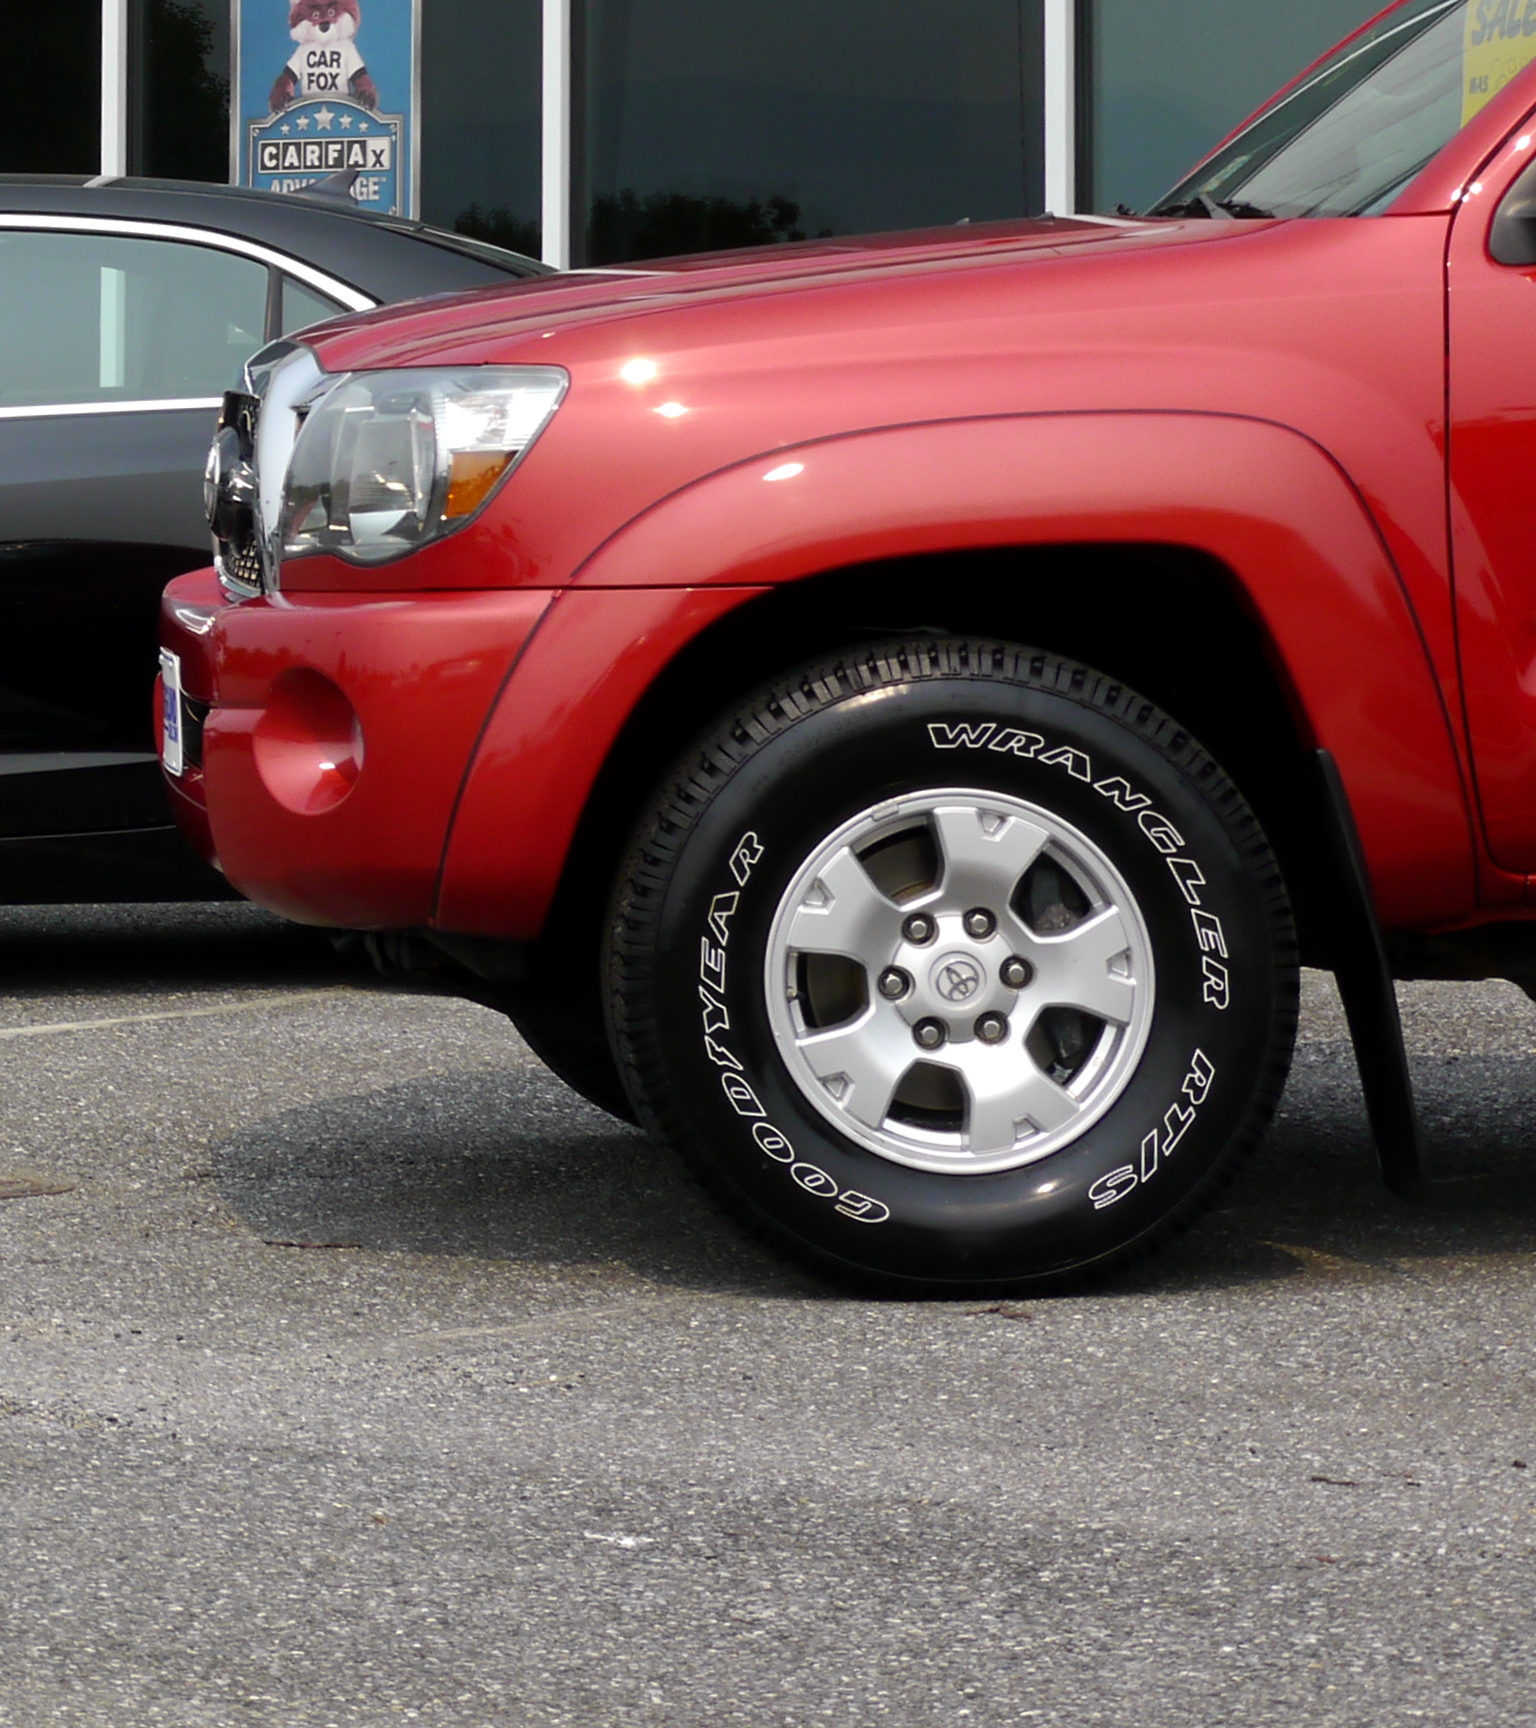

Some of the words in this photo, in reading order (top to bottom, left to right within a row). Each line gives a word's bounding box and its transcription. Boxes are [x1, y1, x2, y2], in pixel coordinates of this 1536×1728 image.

[306, 50, 341, 69] CAR
[307, 72, 339, 91] FOX
[262, 138, 386, 168] CARFAX
[927, 722, 1230, 1010] WRANGLER
[698, 831, 890, 1223] GOODYEAR
